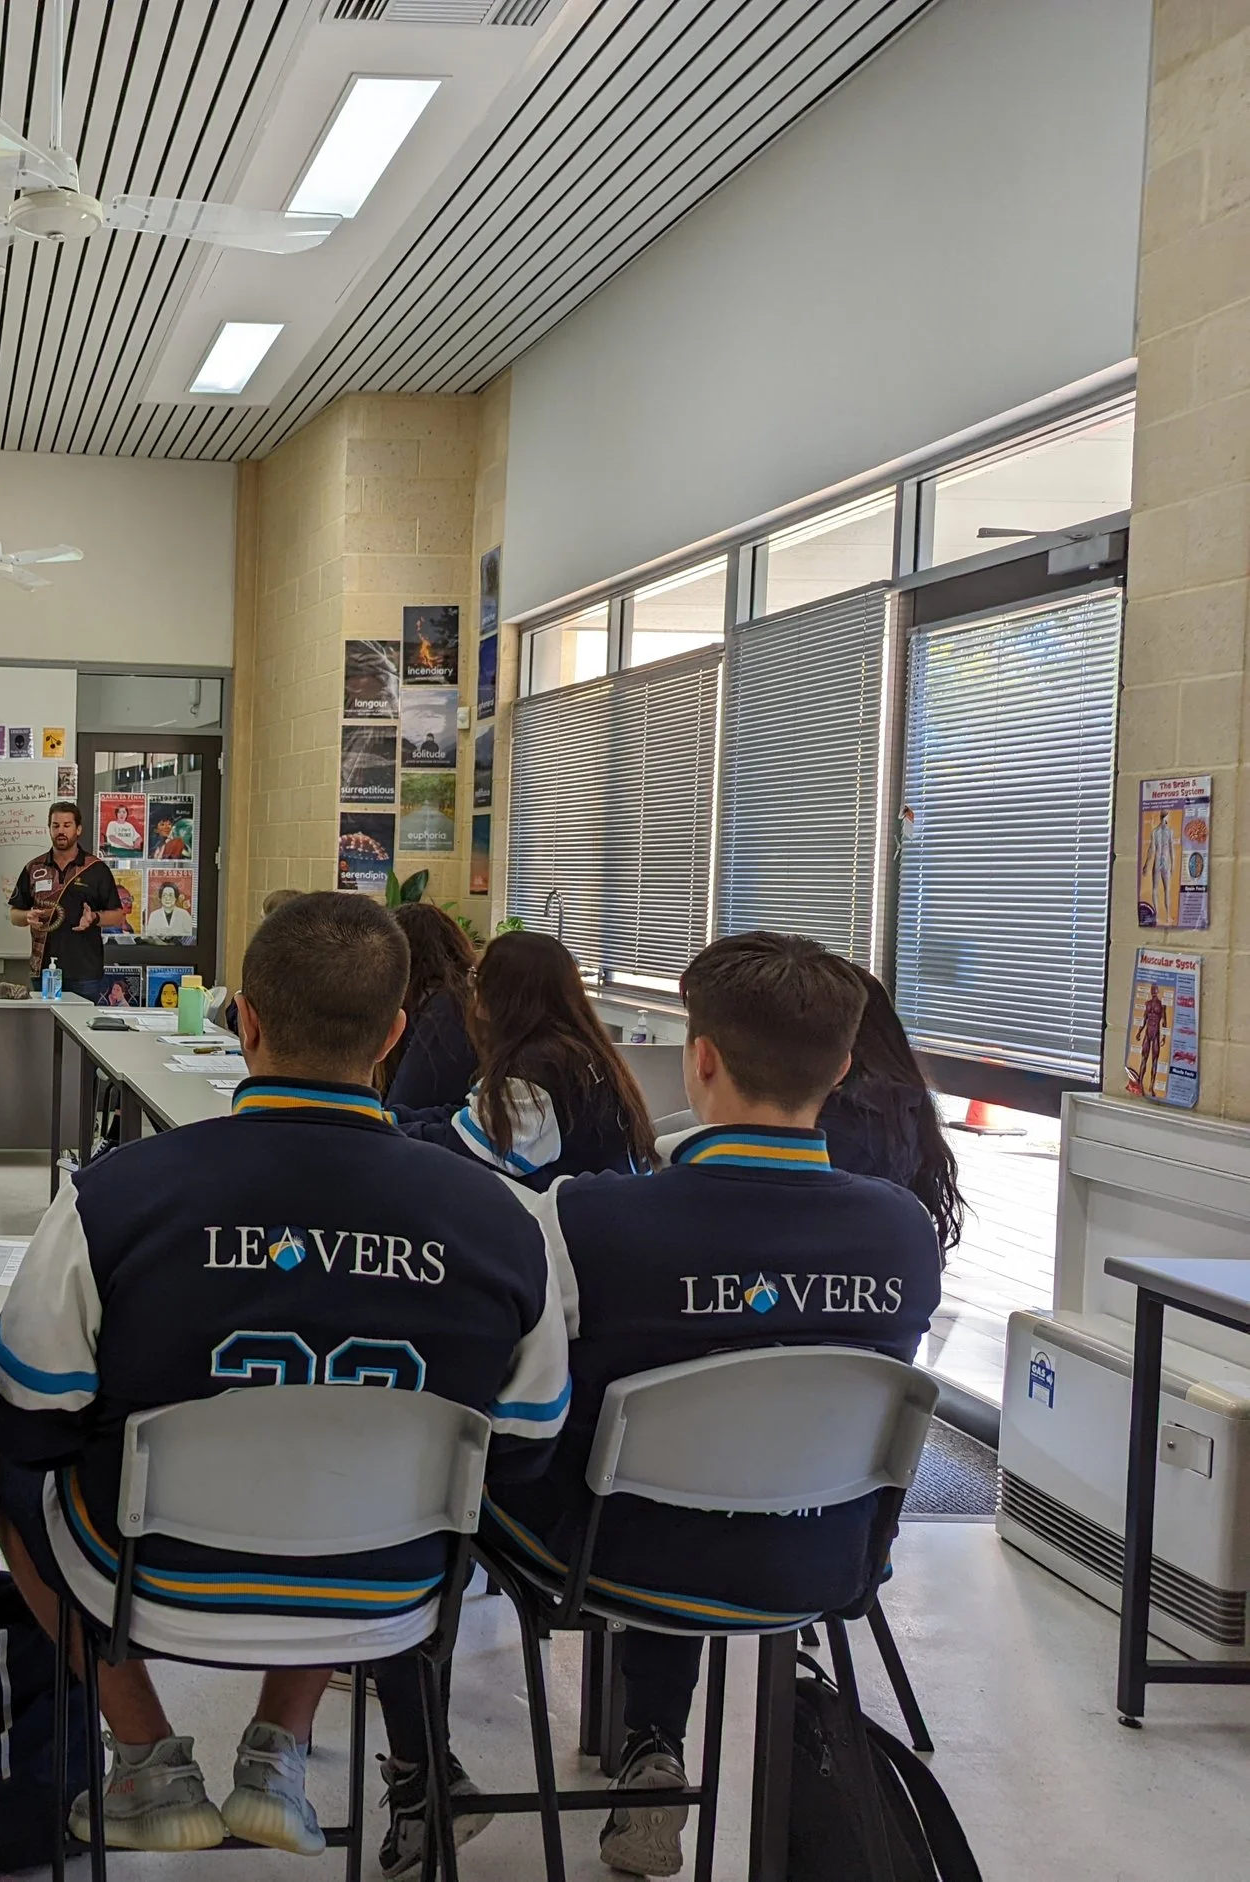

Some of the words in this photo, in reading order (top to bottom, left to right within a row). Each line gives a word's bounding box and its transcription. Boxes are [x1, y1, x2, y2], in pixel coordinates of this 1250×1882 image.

[407, 667, 453, 676] incendiary
[355, 698, 389, 708] langour
[412, 750, 446, 759] solitude
[1173, 780, 1190, 789] Brain
[341, 785, 394, 795] surreptitious
[1152, 790, 1179, 799] Nervous
[1181, 788, 1204, 797] System
[408, 832, 446, 841] euphoria
[341, 871, 388, 880] serendipity
[1141, 955, 1173, 967] Muscular
[203, 1226, 446, 1285] LEAVERS
[680, 1272, 904, 1314] LEAVERS
[1031, 1363, 1047, 1378] GAS
